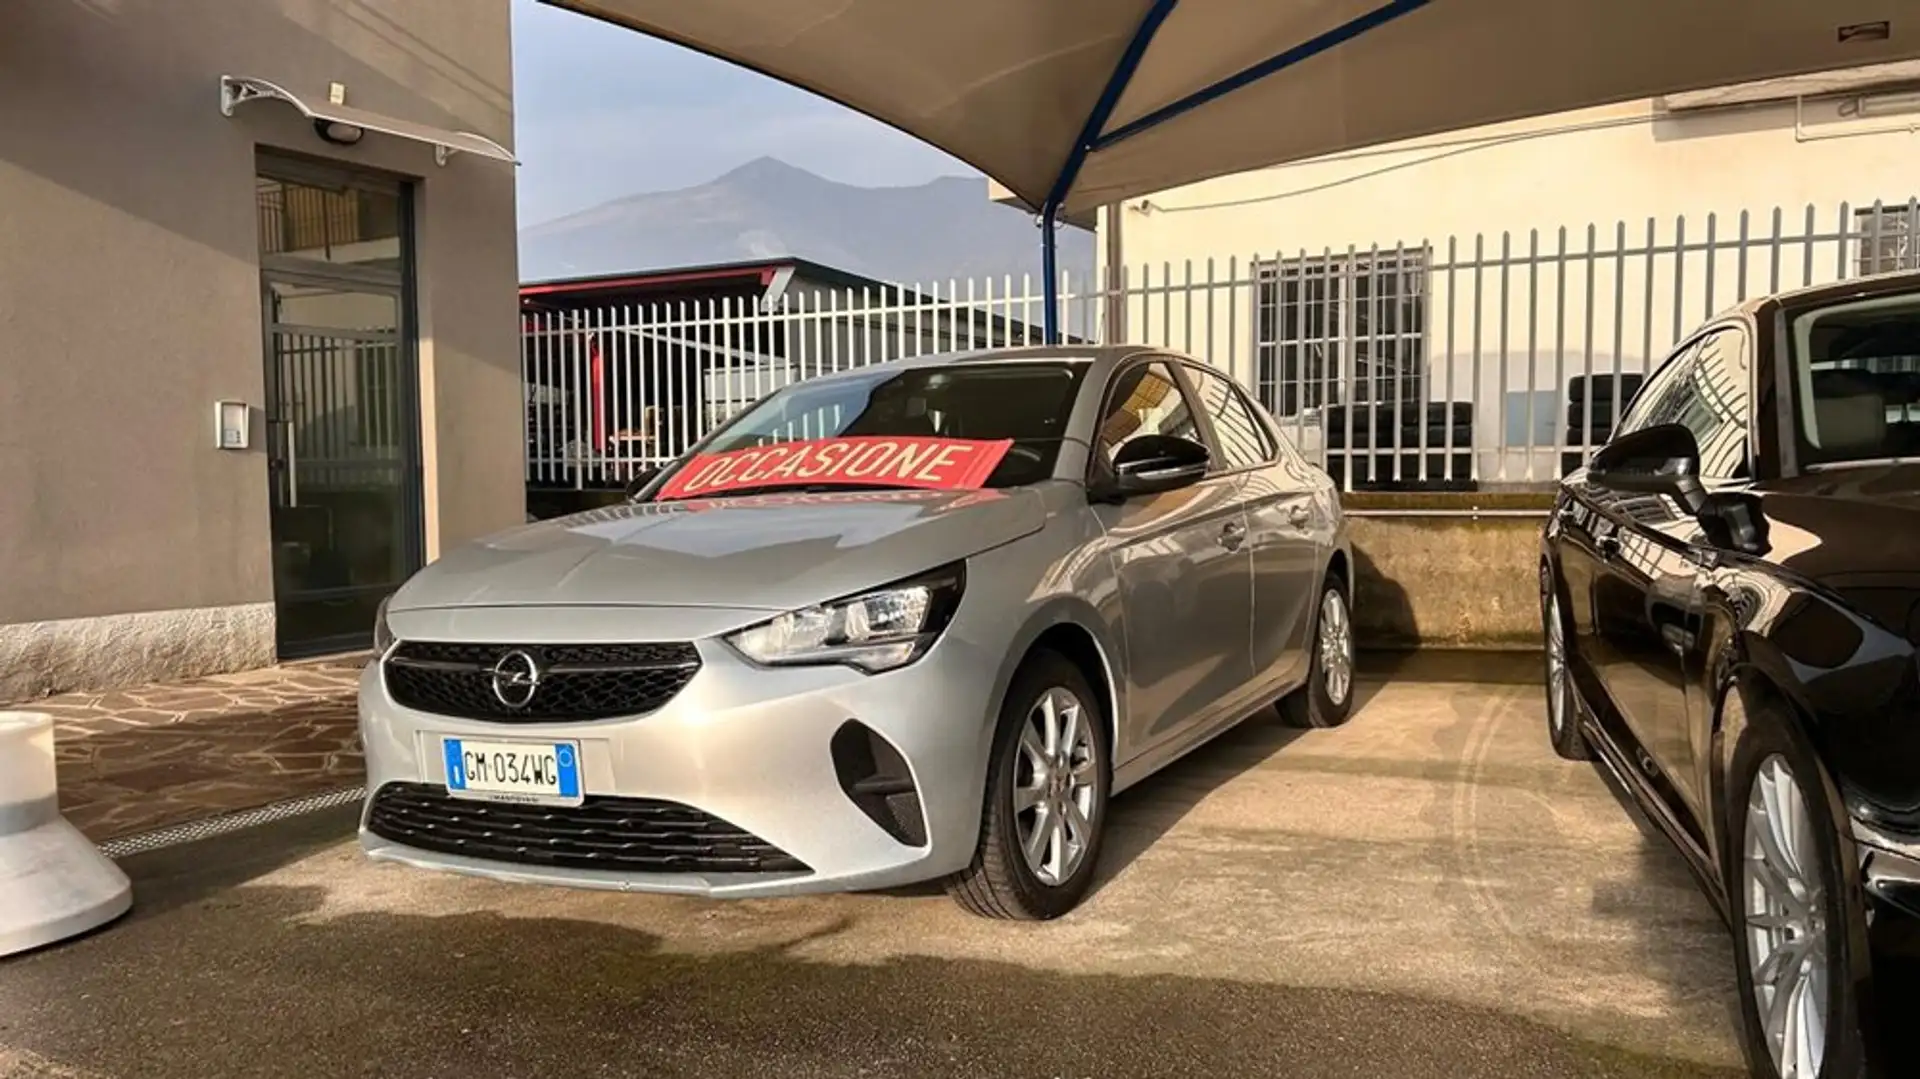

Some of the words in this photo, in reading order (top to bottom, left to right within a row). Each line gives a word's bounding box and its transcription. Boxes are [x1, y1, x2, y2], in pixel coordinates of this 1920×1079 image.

[683, 442, 972, 492] OCCASIONE
[464, 751, 489, 782] GM
[493, 753, 557, 785] 034WG
